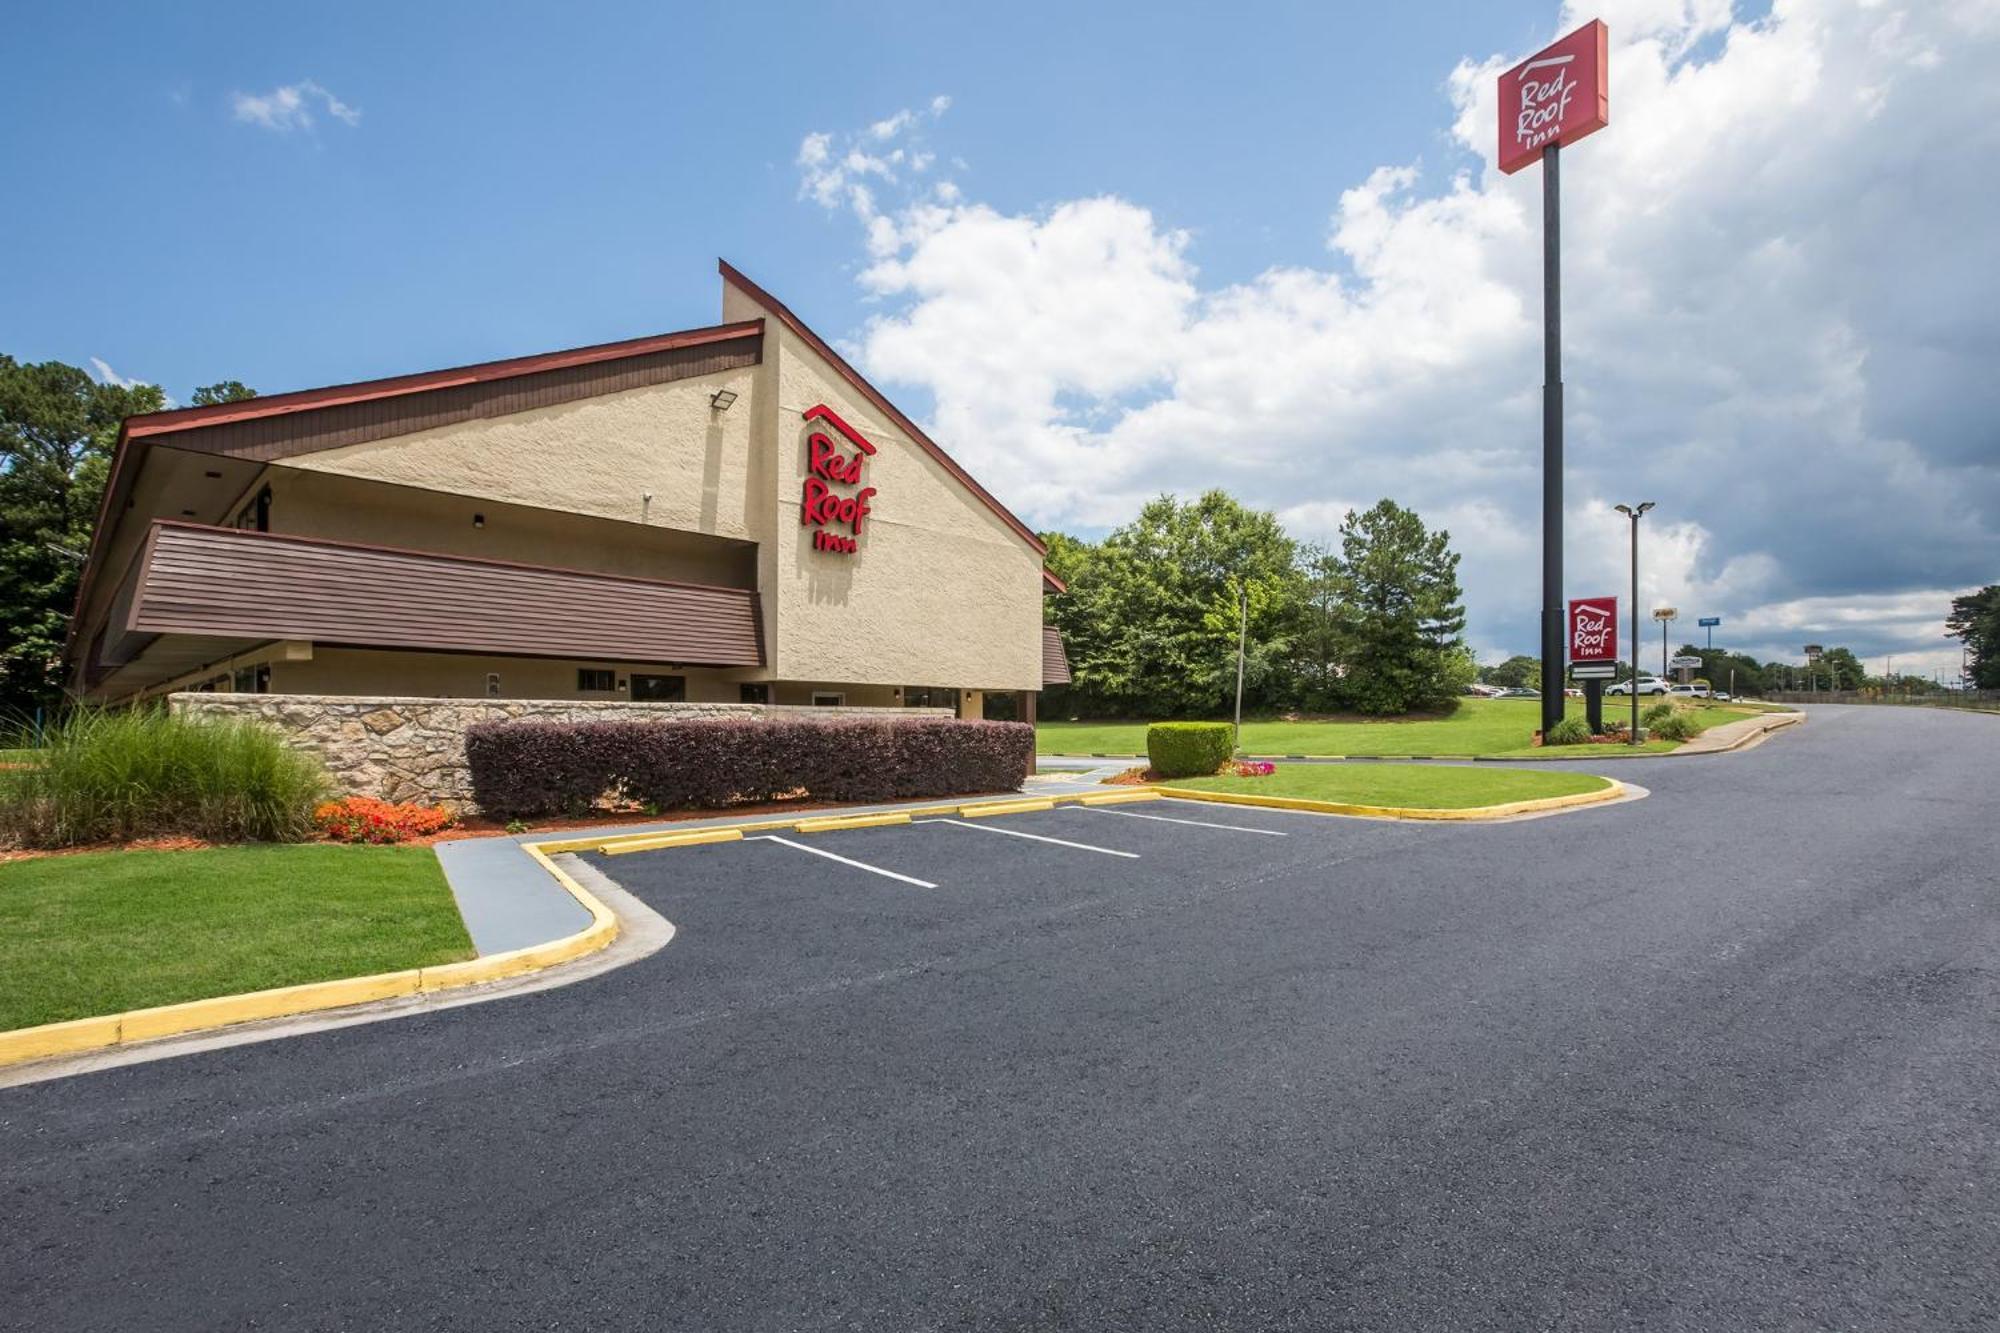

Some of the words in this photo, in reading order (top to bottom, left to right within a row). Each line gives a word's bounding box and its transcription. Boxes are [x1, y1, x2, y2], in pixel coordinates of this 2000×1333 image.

[1517, 80, 1577, 143] Roof
[1521, 67, 1566, 110] Red
[808, 432, 864, 484] Red
[802, 477, 877, 535] Roof
[1574, 627, 1612, 649] Roof
[1577, 615, 1605, 632] Red
